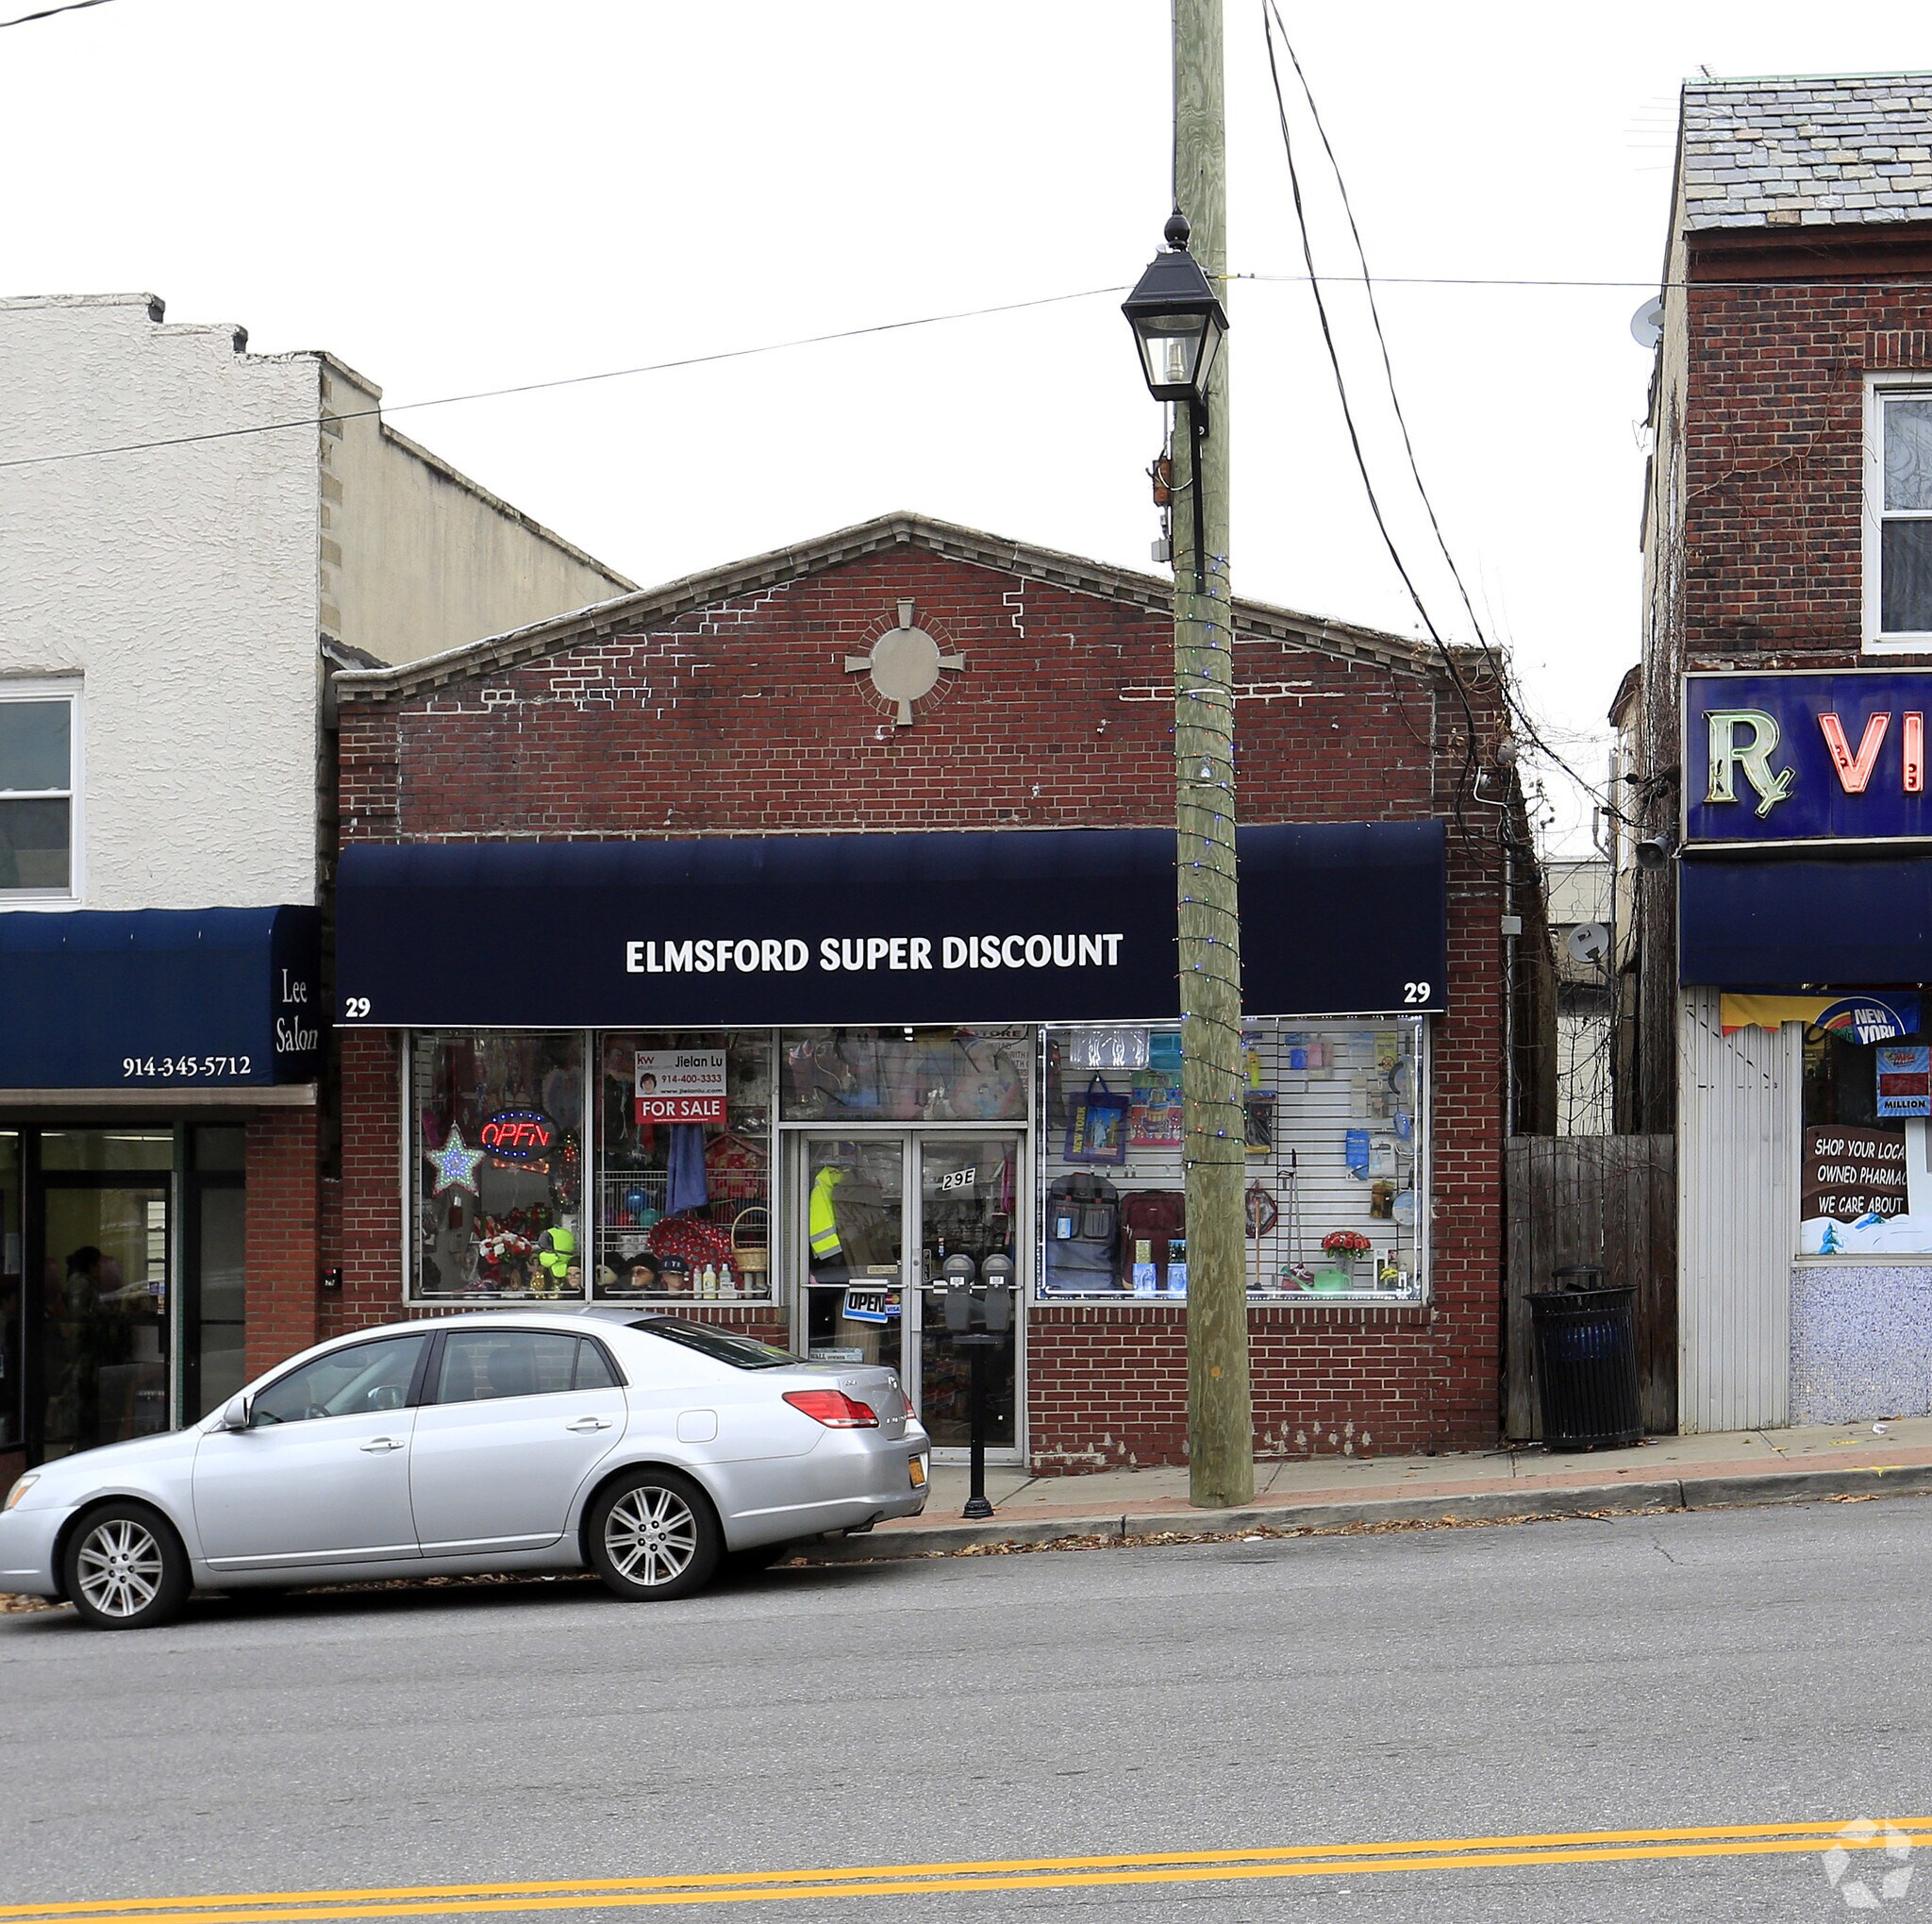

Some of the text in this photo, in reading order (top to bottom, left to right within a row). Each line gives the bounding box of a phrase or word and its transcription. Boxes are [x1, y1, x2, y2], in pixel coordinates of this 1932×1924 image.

[626, 933, 1124, 972] ELMSFORD SUPER DISCOUNT
[282, 968, 308, 1003] Lee
[1404, 982, 1431, 1003] 29
[345, 997, 371, 1018] 29
[1854, 1009, 1888, 1025] NEW
[276, 1015, 319, 1052] Salon
[123, 1056, 252, 1077] 914-345-5712
[637, 1053, 655, 1065] kw
[675, 1055, 723, 1067] Jielan Lu
[662, 1074, 722, 1083] 914-400-3333
[642, 1100, 721, 1116] FOR SALE
[1884, 1100, 1925, 1109] MILLION
[1814, 1138, 1844, 1157] SHOP
[1847, 1140, 1875, 1158] YOUR
[943, 1169, 974, 1189] 29E
[1817, 1165, 1857, 1184] OWNED
[1819, 1196, 1905, 1213] WE CARE ABOUT
[848, 1293, 885, 1313] OPEN
